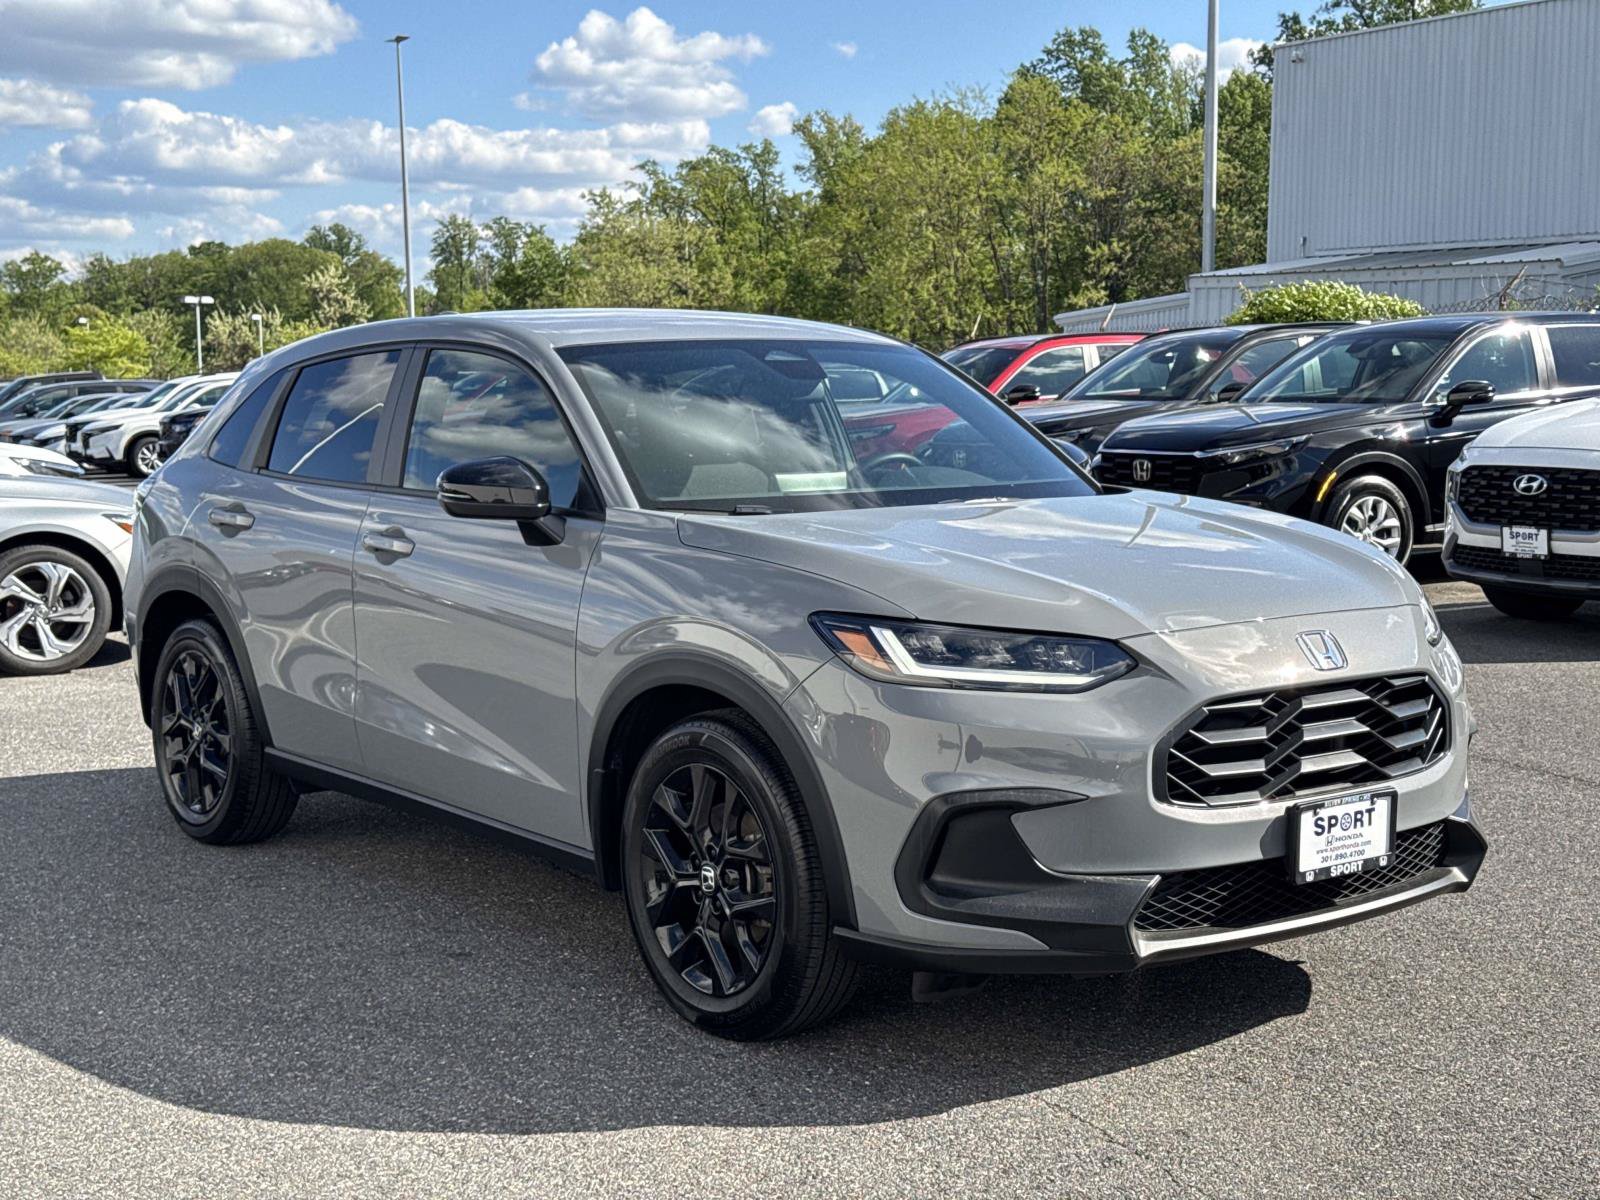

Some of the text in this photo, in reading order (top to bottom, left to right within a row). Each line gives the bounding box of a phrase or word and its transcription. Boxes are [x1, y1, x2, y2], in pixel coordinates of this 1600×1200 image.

[1509, 530, 1539, 541] SPORT
[1314, 807, 1375, 836] SPORT
[1335, 833, 1363, 842] HONDA
[1316, 840, 1371, 854] www.sporthonda.com
[1321, 849, 1365, 863] 301.890.4700
[1330, 860, 1363, 877] SPORT
